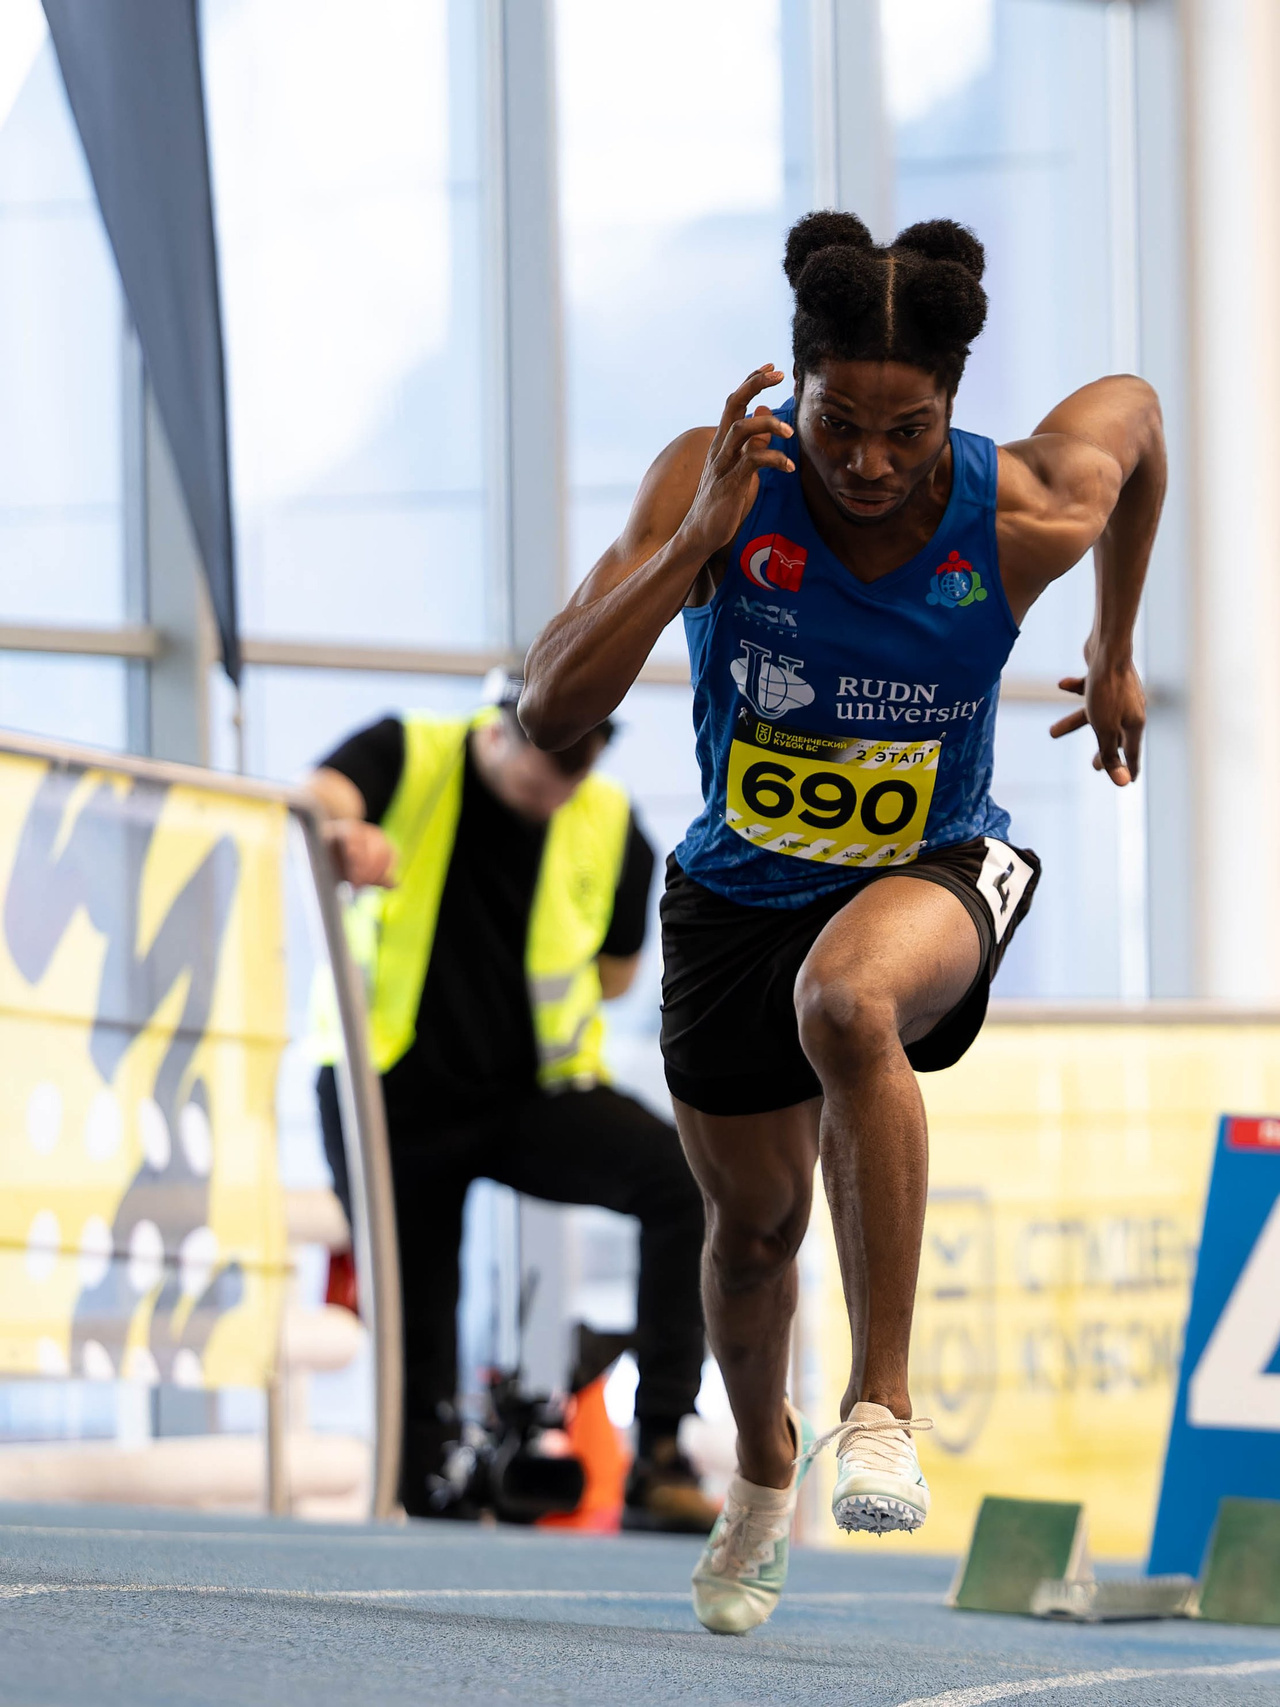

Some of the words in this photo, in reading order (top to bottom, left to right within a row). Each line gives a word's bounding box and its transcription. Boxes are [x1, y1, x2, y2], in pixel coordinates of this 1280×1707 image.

[836, 676, 939, 704] RUDN
[836, 697, 985, 723] university
[773, 738, 804, 750] КУБОК
[774, 730, 848, 749] СТУДЕНЧЕСКИЙ
[855, 749, 867, 761] 2
[874, 751, 925, 763] ЭТАП
[741, 761, 918, 836] 690
